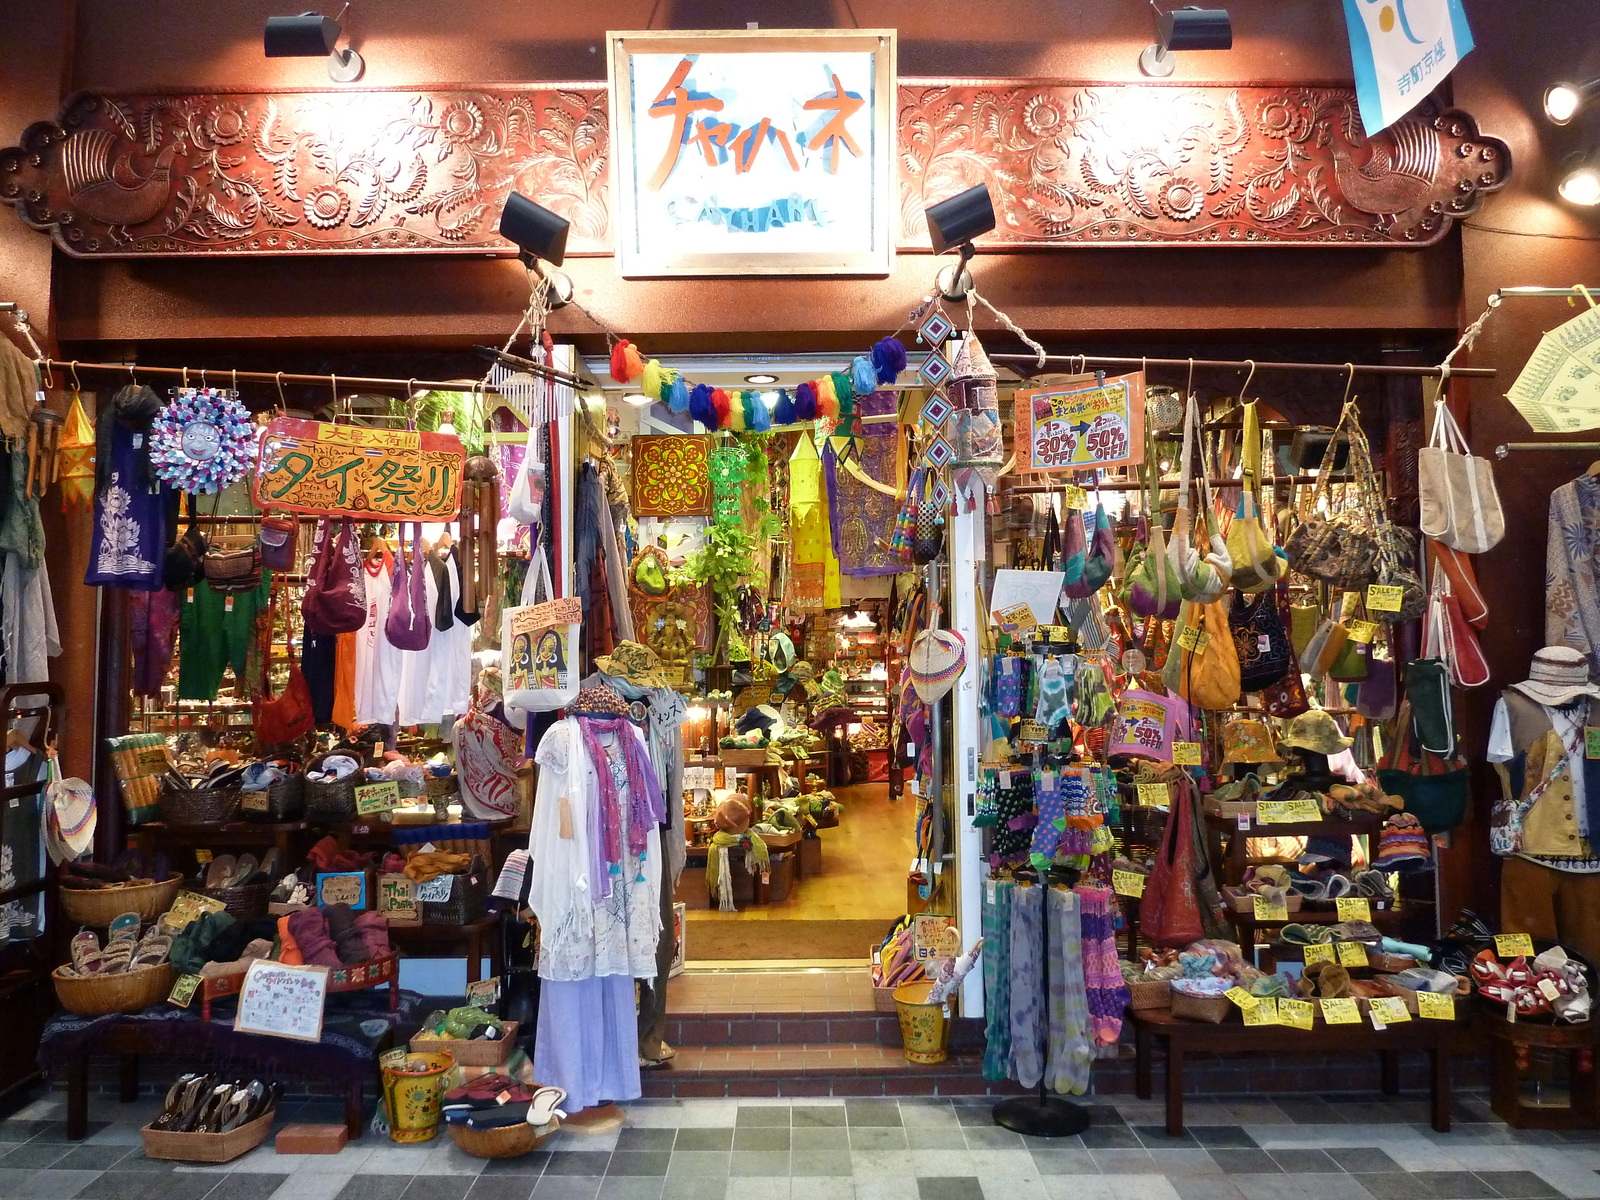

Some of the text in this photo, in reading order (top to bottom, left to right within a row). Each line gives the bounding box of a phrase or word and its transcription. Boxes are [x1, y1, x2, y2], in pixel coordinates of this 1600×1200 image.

[1397, 38, 1446, 96] 寺町京極
[648, 60, 866, 192] チャイハネ
[302, 444, 358, 457] Thailand
[1036, 433, 1077, 457] 30%
[1086, 426, 1125, 452] 50%
[1043, 449, 1073, 465] OFF!
[269, 451, 450, 511] タイ祭り
[656, 698, 682, 726] メンズ
[1134, 726, 1162, 742] 50%
[382, 881, 409, 898] Thai
